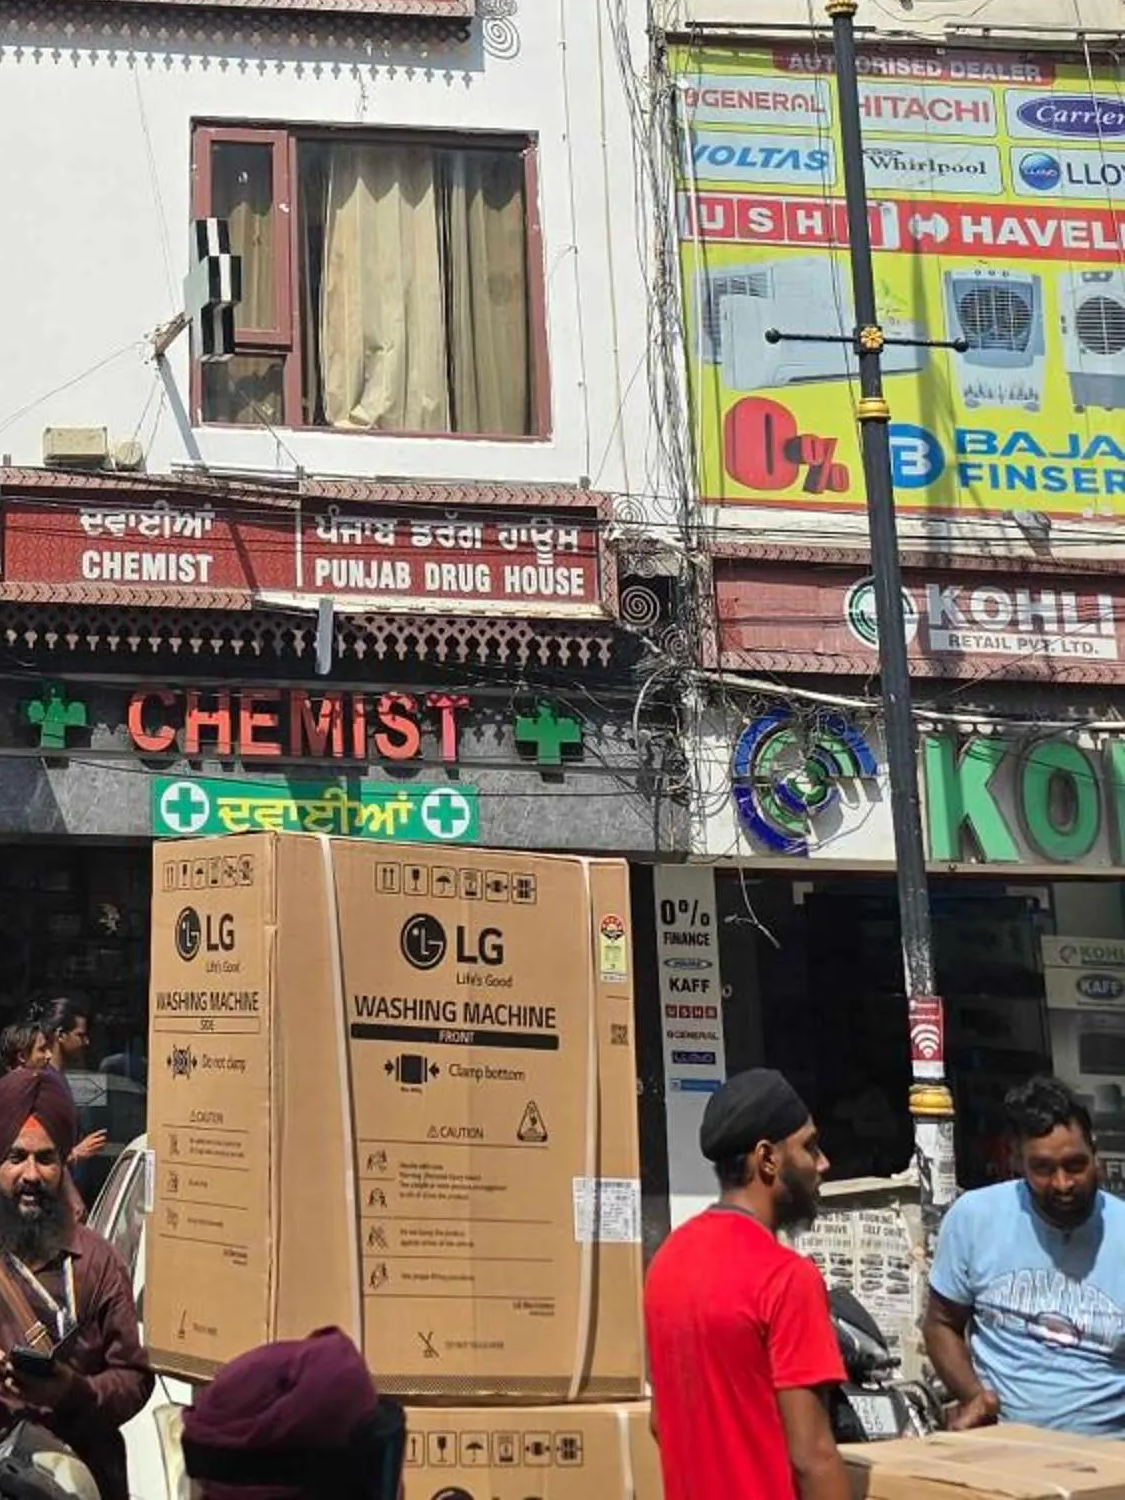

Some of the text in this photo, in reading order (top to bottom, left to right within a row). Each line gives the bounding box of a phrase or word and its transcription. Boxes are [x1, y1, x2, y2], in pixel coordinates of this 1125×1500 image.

[788, 52, 1042, 83] AUTORISED DEALER
[864, 154, 988, 177] Whirlpool
[1066, 161, 1125, 186] LLO
[700, 204, 870, 236] USH
[961, 215, 1125, 250] HAVEL
[724, 395, 850, 495] 0%
[315, 504, 398, 545] ਪੰਜਾਬ
[82, 550, 214, 583] CHEMIST
[315, 559, 585, 596] PUNJAB DRUG HOUSE
[925, 583, 1115, 635] KOHLI
[948, 633, 1011, 651] RETAIL
[1061, 639, 1099, 655] LTD.
[126, 690, 469, 762] CHEMIST
[924, 735, 1125, 863] KO
[661, 899, 710, 926] 0%
[206, 913, 235, 951] LG
[456, 925, 504, 966] LG
[663, 931, 711, 946] FINANCE
[456, 972, 513, 988] Life's Good
[669, 977, 710, 993] KAFF
[156, 991, 259, 1011] WASHING MACHINE
[354, 995, 557, 1029] WASHING MACHINE
[439, 1031, 475, 1044] FRONT
[448, 1063, 525, 1081] Clamp bottom
[440, 1126, 484, 1140] CAUTION
